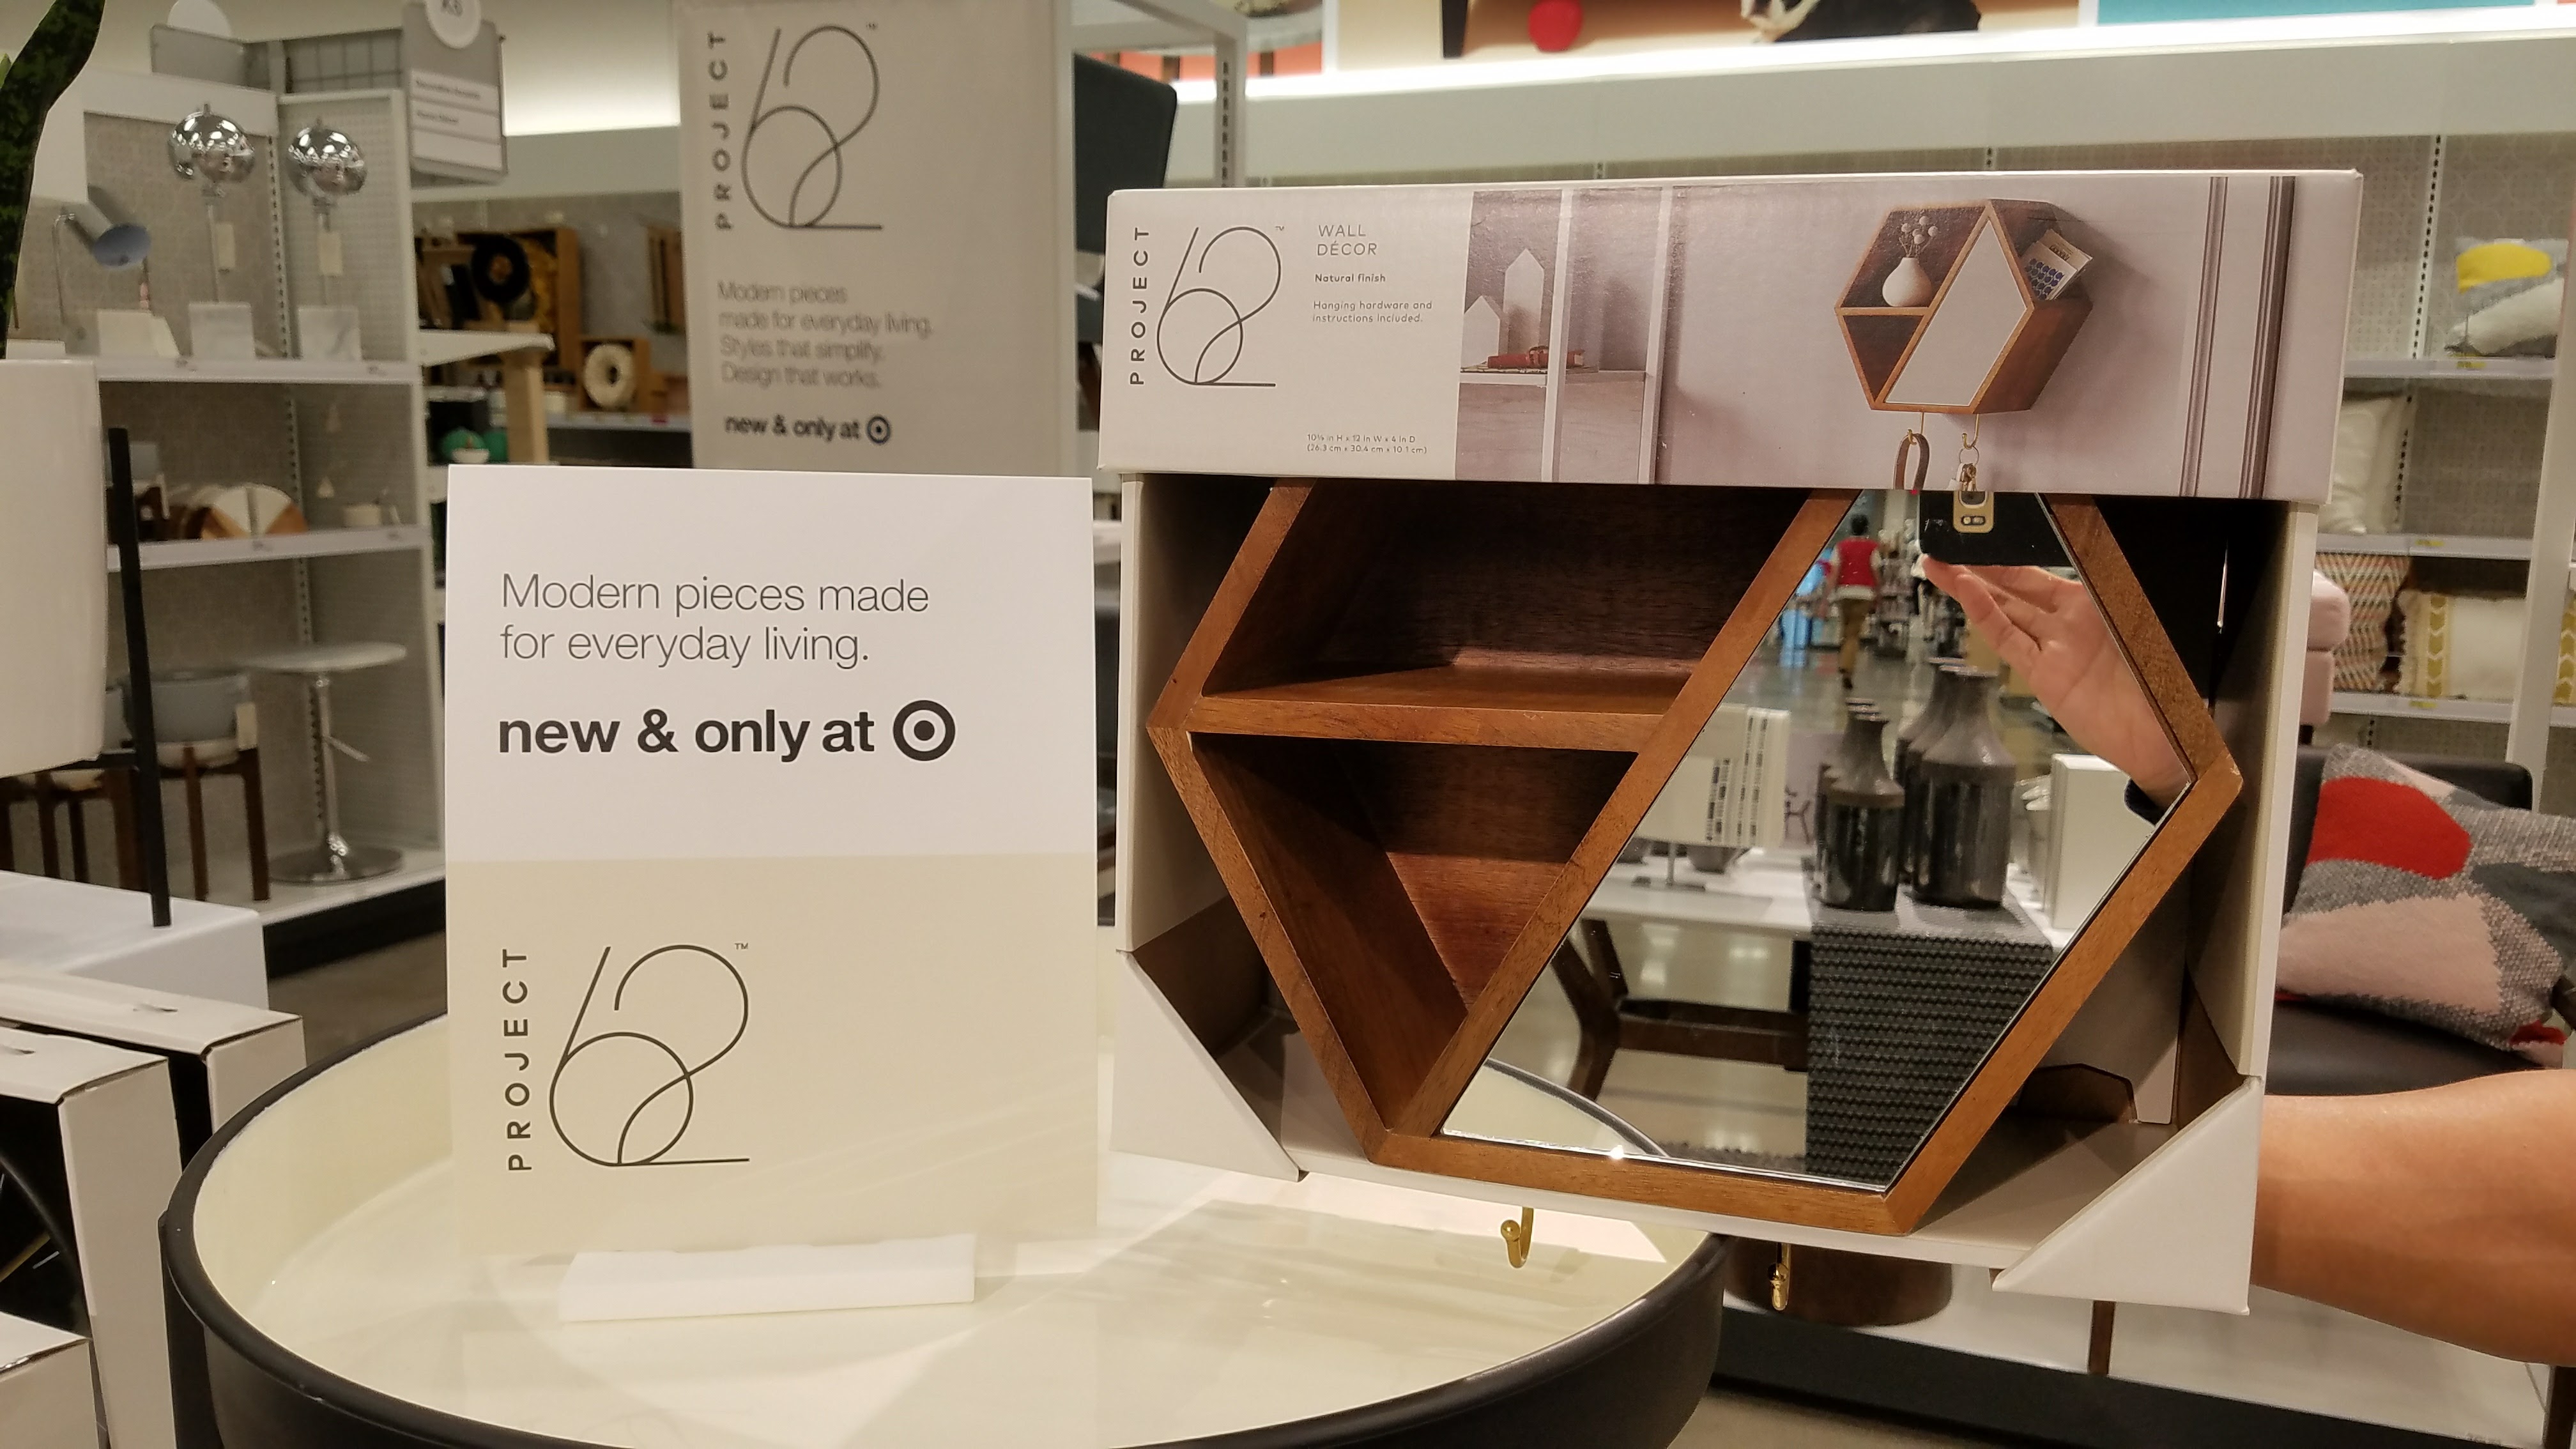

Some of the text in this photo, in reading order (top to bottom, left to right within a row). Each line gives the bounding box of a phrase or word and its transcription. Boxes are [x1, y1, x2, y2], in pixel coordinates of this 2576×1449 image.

[707, 31, 732, 230] PROJECT
[1318, 224, 1367, 238] WALL
[1317, 240, 1377, 256] DÉCOR
[1314, 273, 1386, 283] Natural finish
[718, 280, 847, 307] Modern pieces
[1129, 226, 1150, 386] PROJECT
[1157, 226, 1282, 387] 62
[1313, 300, 1433, 312] Hanging hardware and
[718, 310, 769, 330] made
[771, 310, 797, 330] for
[799, 312, 880, 337] everyday
[1312, 312, 1424, 323] instructions included.
[720, 335, 773, 362] Styles
[776, 337, 810, 358] that
[721, 360, 783, 390] Design
[785, 367, 819, 387] that
[725, 413, 861, 443] new & only at
[1409, 435, 1416, 443] D
[1411, 446, 1428, 454] cm)
[503, 573, 930, 617] Modern pieces made
[500, 625, 869, 670] for everyday living.
[499, 709, 875, 763] new & only at
[502, 948, 532, 1171] PROJECT
[549, 943, 750, 1168] 62
